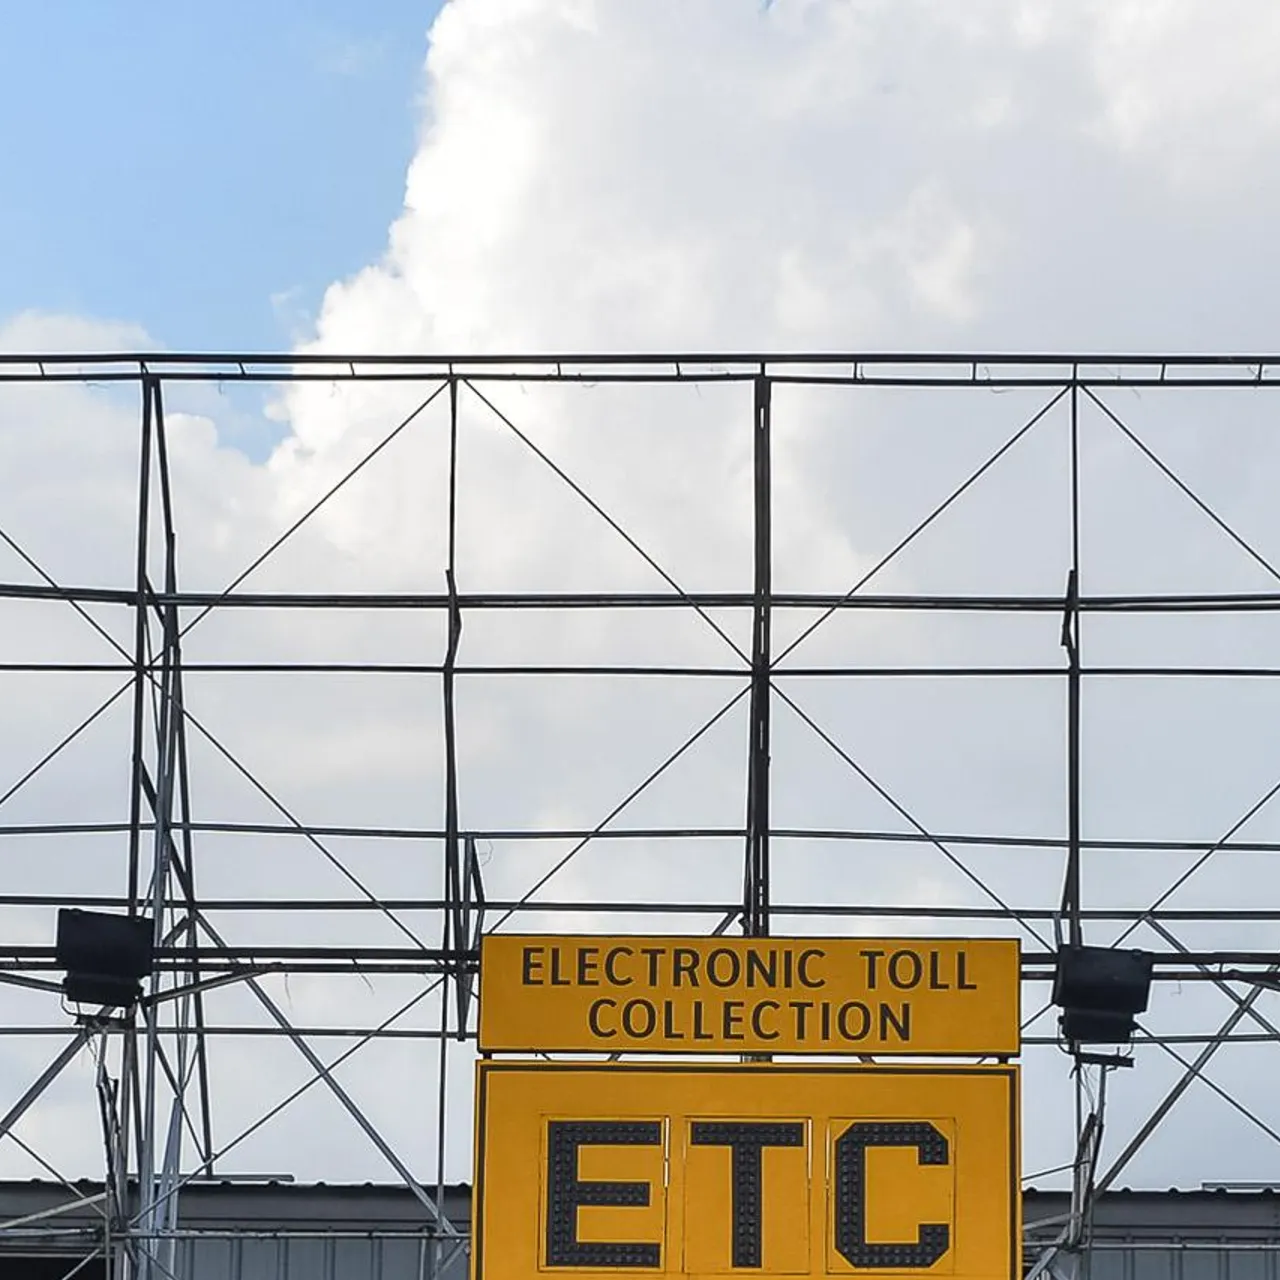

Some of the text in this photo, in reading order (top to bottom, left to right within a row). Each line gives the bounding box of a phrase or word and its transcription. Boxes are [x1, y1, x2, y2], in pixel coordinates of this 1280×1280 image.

[521, 947, 977, 991] ELECTRONIC TOLL
[589, 999, 911, 1041] COLLECTION
[546, 1121, 949, 1268] ETC
